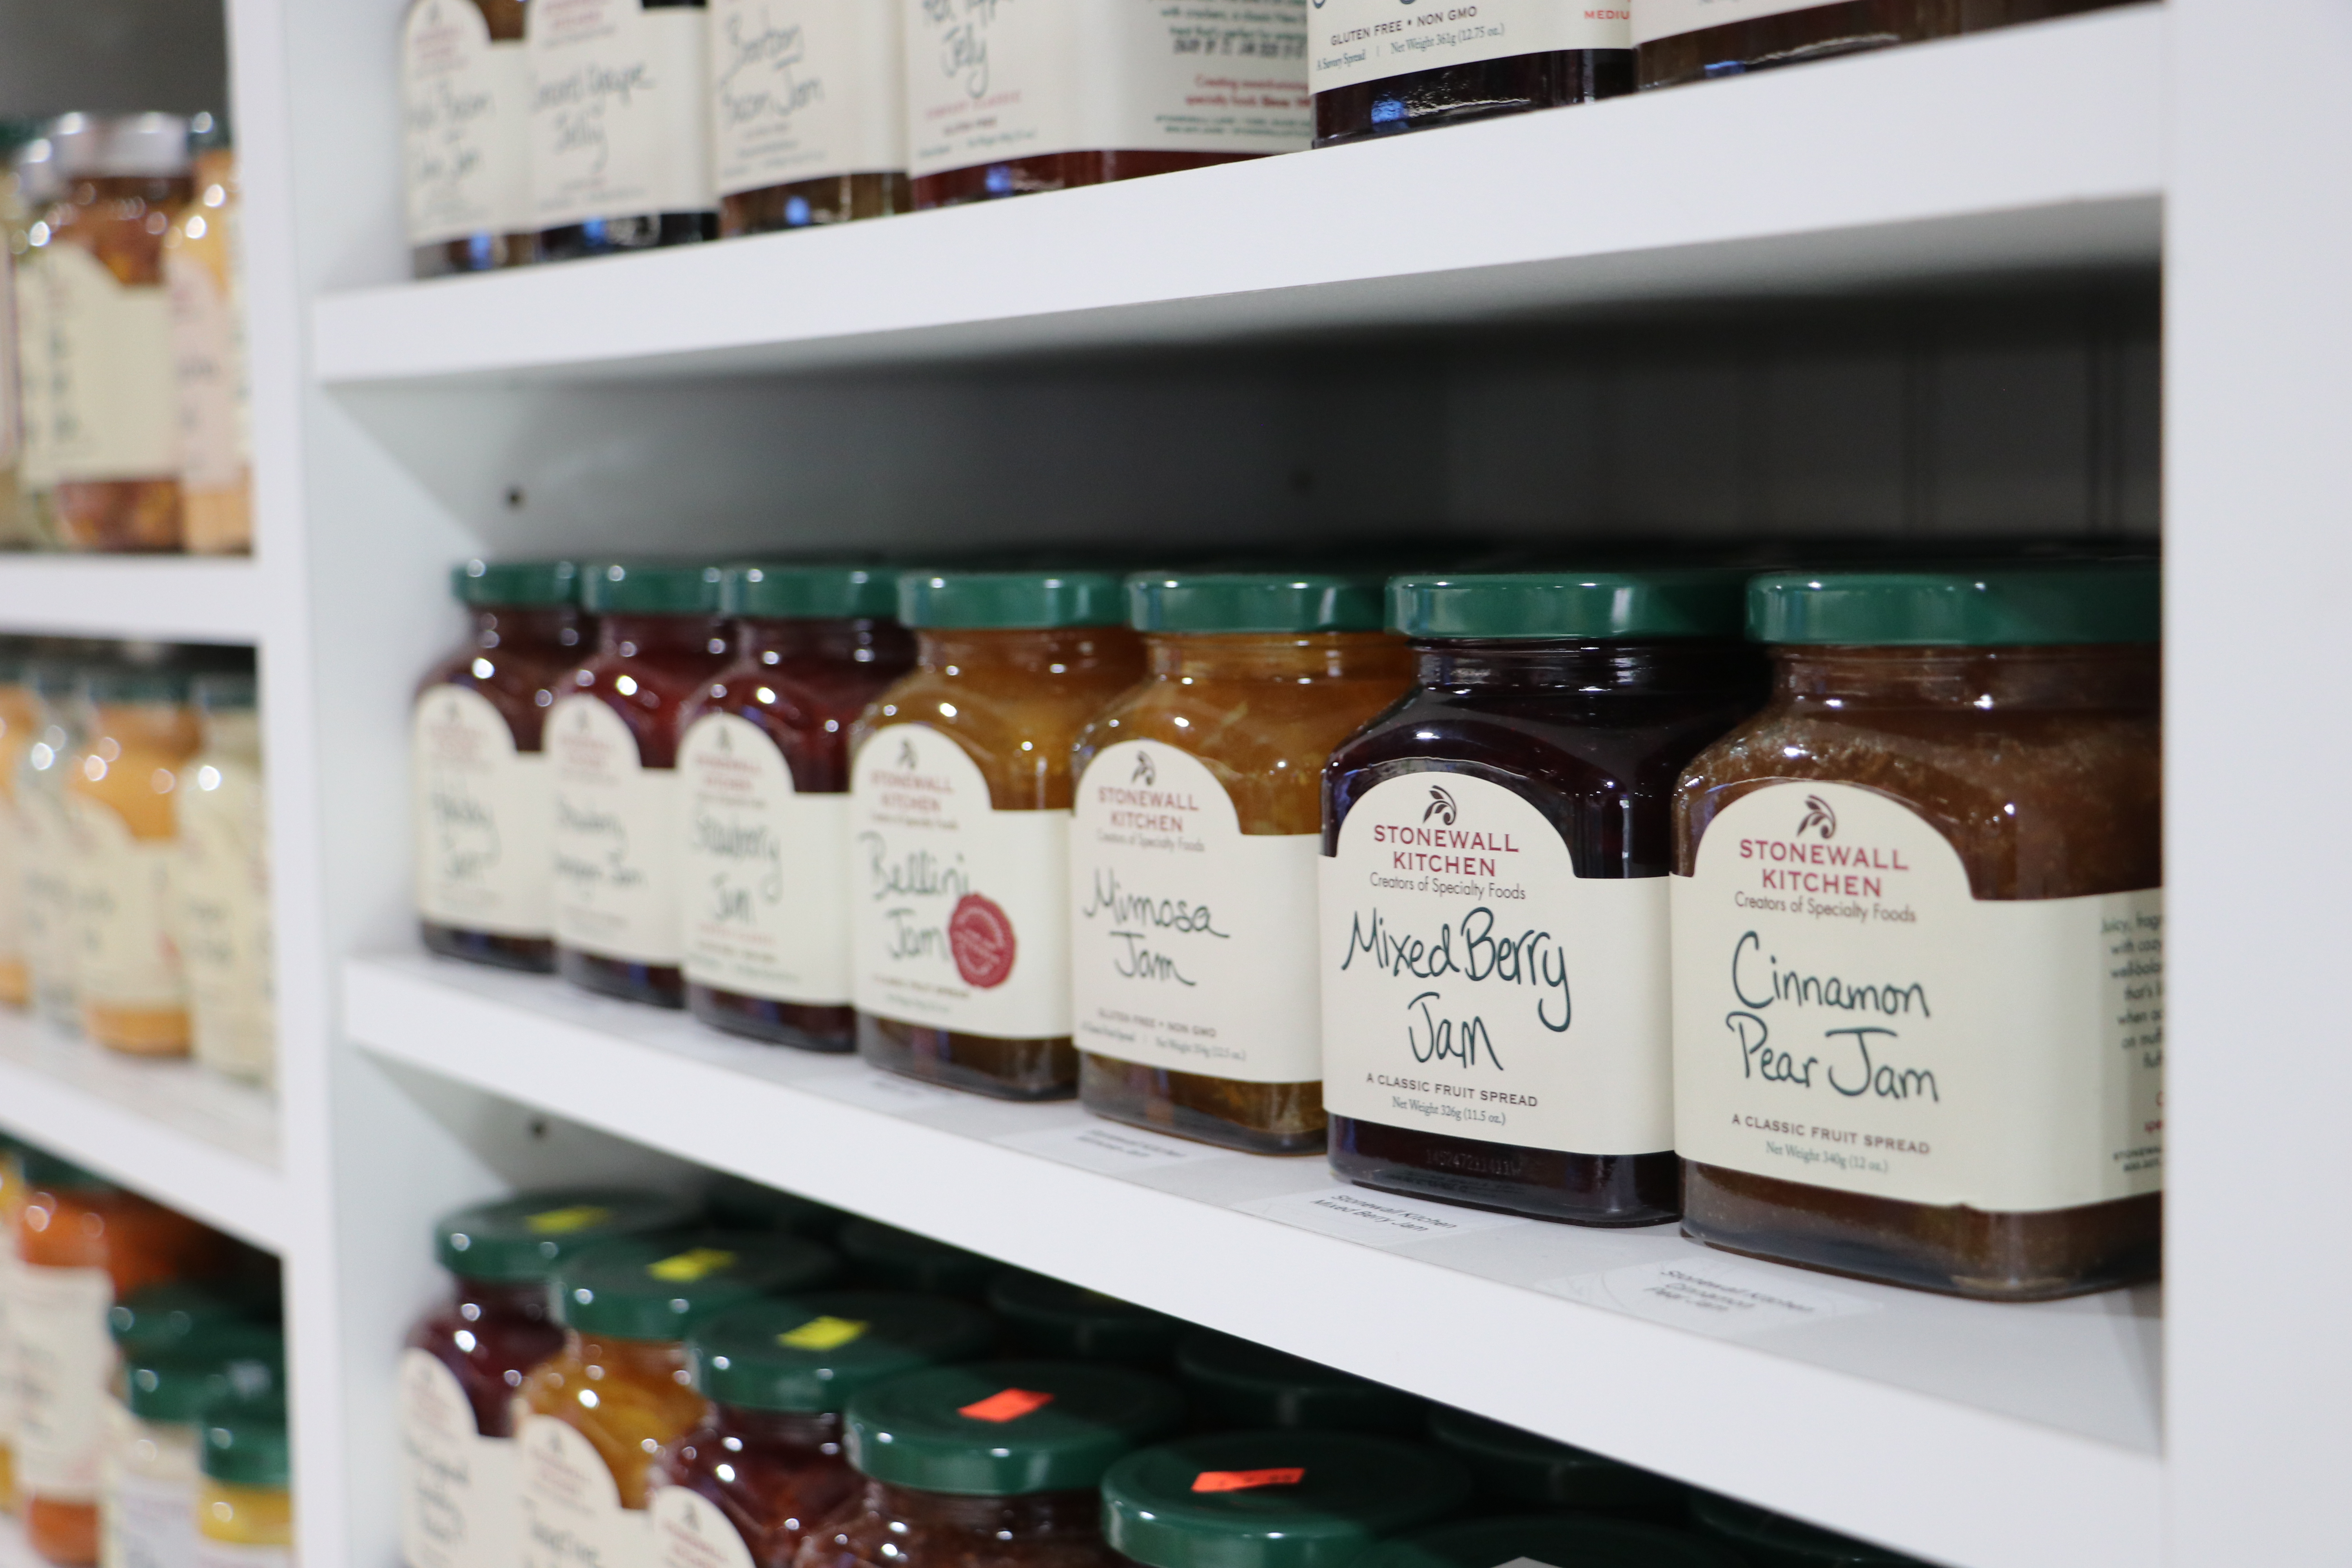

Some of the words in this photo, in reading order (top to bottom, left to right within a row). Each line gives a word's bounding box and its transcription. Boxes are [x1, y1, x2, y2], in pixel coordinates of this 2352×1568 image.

[1331, 27, 1371, 46] GLUTEN
[1374, 20, 1403, 37] FREE
[1417, 11, 1444, 27] NON
[1447, 6, 1477, 22] GMO
[1584, 10, 1630, 19] MEDIU
[1343, 49, 1367, 67] Spread
[1391, 42, 1405, 54] Net
[1406, 36, 1434, 52] Weight
[1098, 786, 1200, 811] STONEWALL
[1111, 810, 1183, 832] KITCHEN
[1374, 824, 1519, 853] STONEWALL
[1739, 838, 1909, 871] STONEWALL
[858, 830, 969, 901] Bellini
[1393, 851, 1496, 877] KITCHEN
[1370, 872, 1414, 891] Creators
[1418, 874, 1430, 891] of
[1432, 878, 1485, 900] Specialty
[1488, 883, 1526, 900] Foods
[1762, 868, 1882, 897] KITCHEN
[1083, 866, 1230, 938] Mimosa
[1735, 891, 1786, 912] Creators
[1791, 894, 1803, 914] of
[1808, 900, 1869, 923] Specialty
[1873, 903, 1916, 923] Foods
[1109, 931, 1197, 987] Jam
[1341, 907, 1460, 978] Mixed
[1461, 907, 1572, 1033] Berry
[1732, 931, 1930, 1018] Cinnamon
[1408, 992, 1504, 1071] Jam
[1726, 1011, 1818, 1088] Pear
[1825, 1027, 1939, 1102] Jam
[1366, 1073, 1374, 1084] A
[1377, 1074, 1430, 1092] CLASSIC
[1435, 1083, 1475, 1099] FRUIT
[1480, 1090, 1538, 1107] SPREAD
[1392, 1096, 1408, 1109] Net
[1411, 1098, 1439, 1114] Weight
[1441, 1103, 1462, 1121] 326g
[1463, 1107, 1486, 1122] (11.5
[1488, 1112, 1506, 1126] oz.)
[1732, 1113, 1741, 1125] A
[1745, 1116, 1805, 1136] CLASSIC
[1811, 1127, 1858, 1145] FRUIT
[1864, 1134, 1931, 1154] SPREAD
[1766, 1141, 1784, 1154] Net
[1786, 1143, 1820, 1163] Weight
[1310, 1198, 1354, 1212] Mixed
[1353, 1210, 1396, 1223] Berry
[1392, 1220, 1429, 1232] Jam
[1331, 1194, 1400, 1215] Stonewall
[1398, 1211, 1457, 1229] Kitchen
